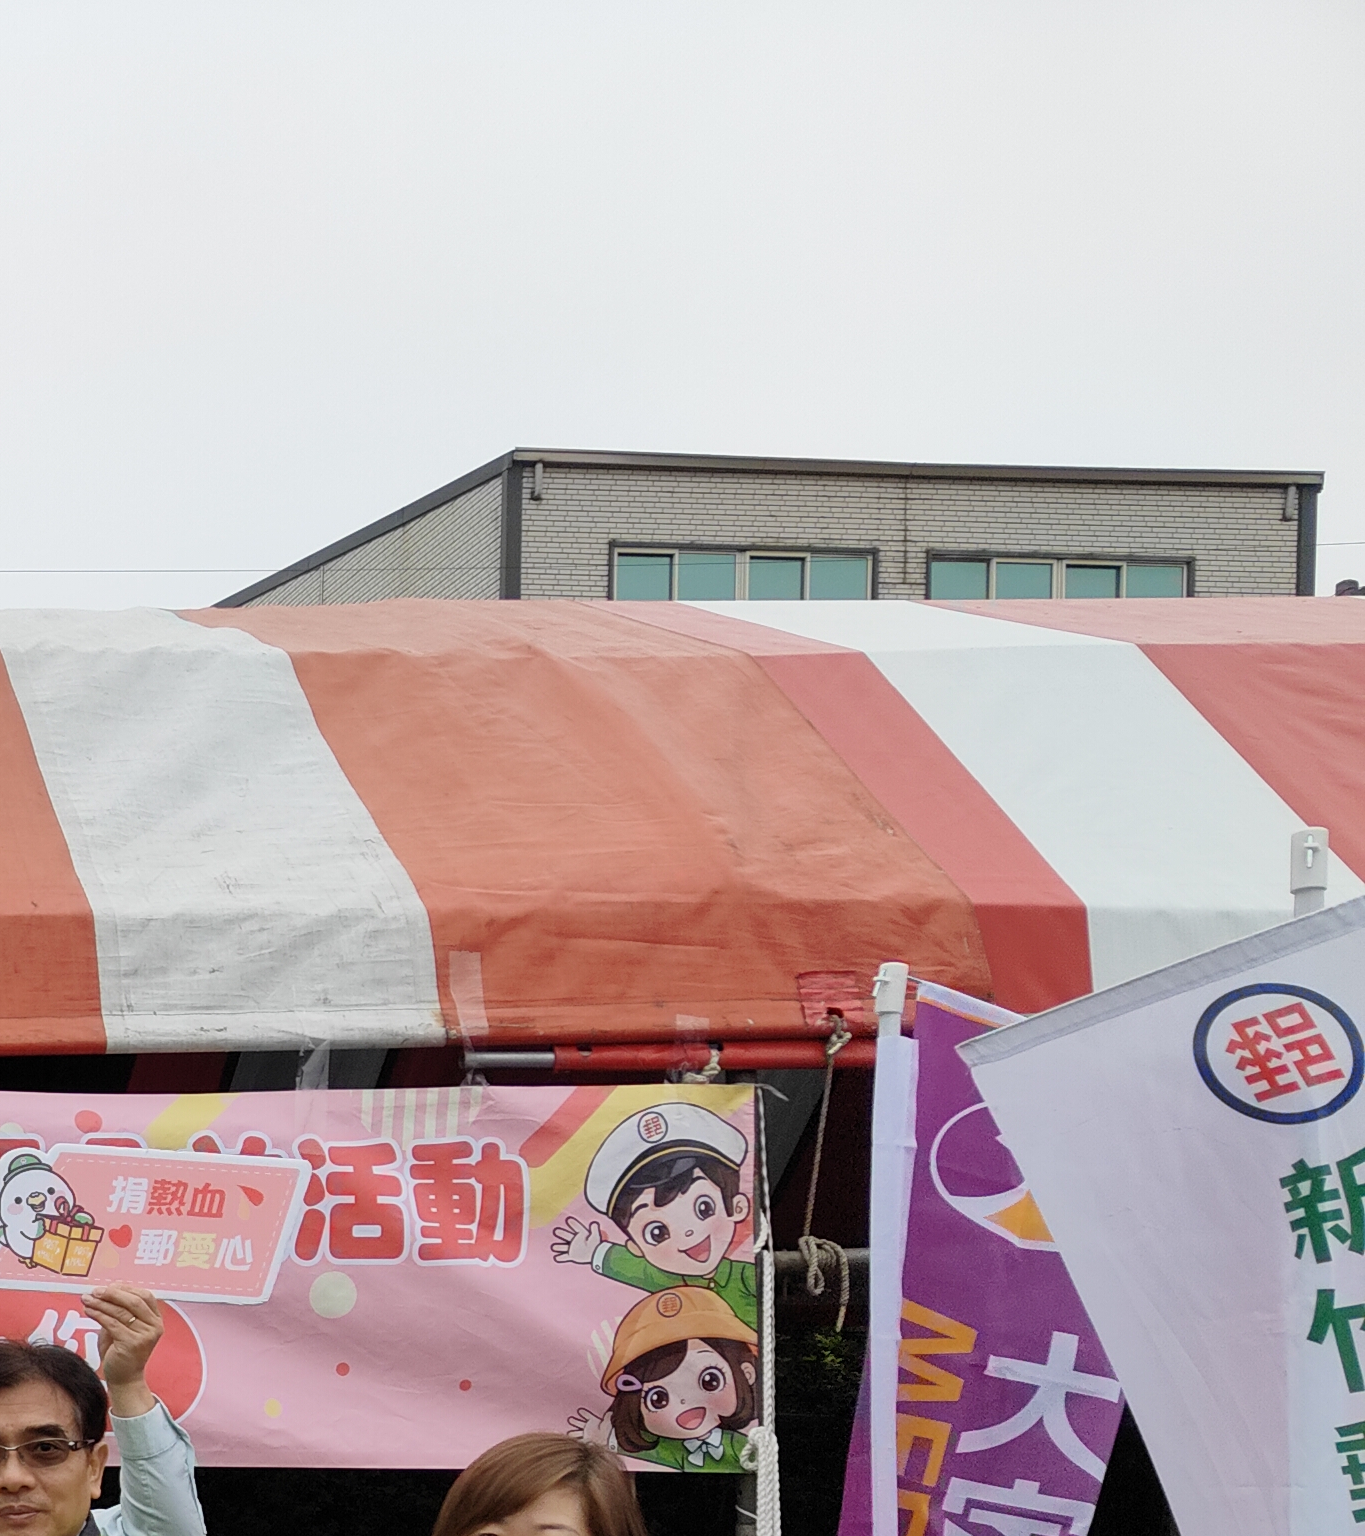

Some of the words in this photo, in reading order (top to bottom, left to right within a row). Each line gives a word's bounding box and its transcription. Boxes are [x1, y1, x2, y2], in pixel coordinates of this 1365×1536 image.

[1225, 1002, 1346, 1103] 郵
[107, 1176, 226, 1219] 捐熱血
[134, 1229, 253, 1271] 郵愛心
